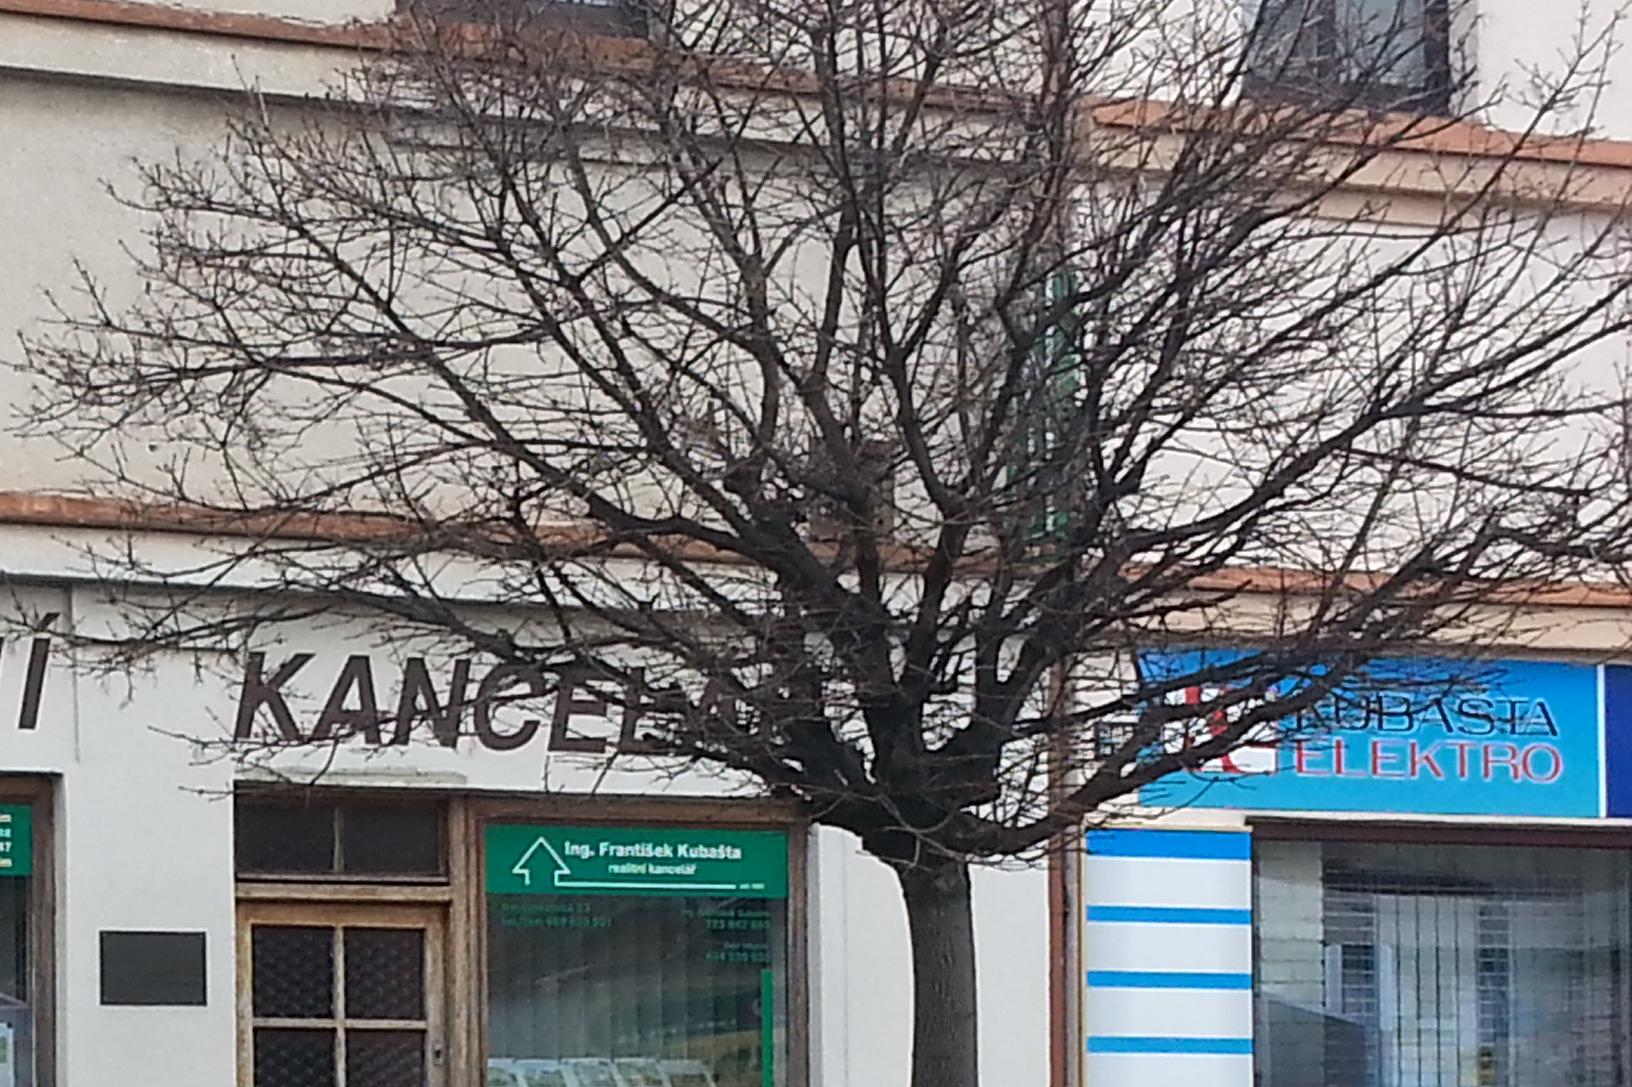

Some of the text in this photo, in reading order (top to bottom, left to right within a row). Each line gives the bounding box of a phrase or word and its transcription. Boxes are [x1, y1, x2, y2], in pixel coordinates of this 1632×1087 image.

[1294, 737, 1564, 784] ELEKTRO
[564, 841, 742, 859] Ing. František Kubašta
[608, 863, 697, 876] realitní kancelář
